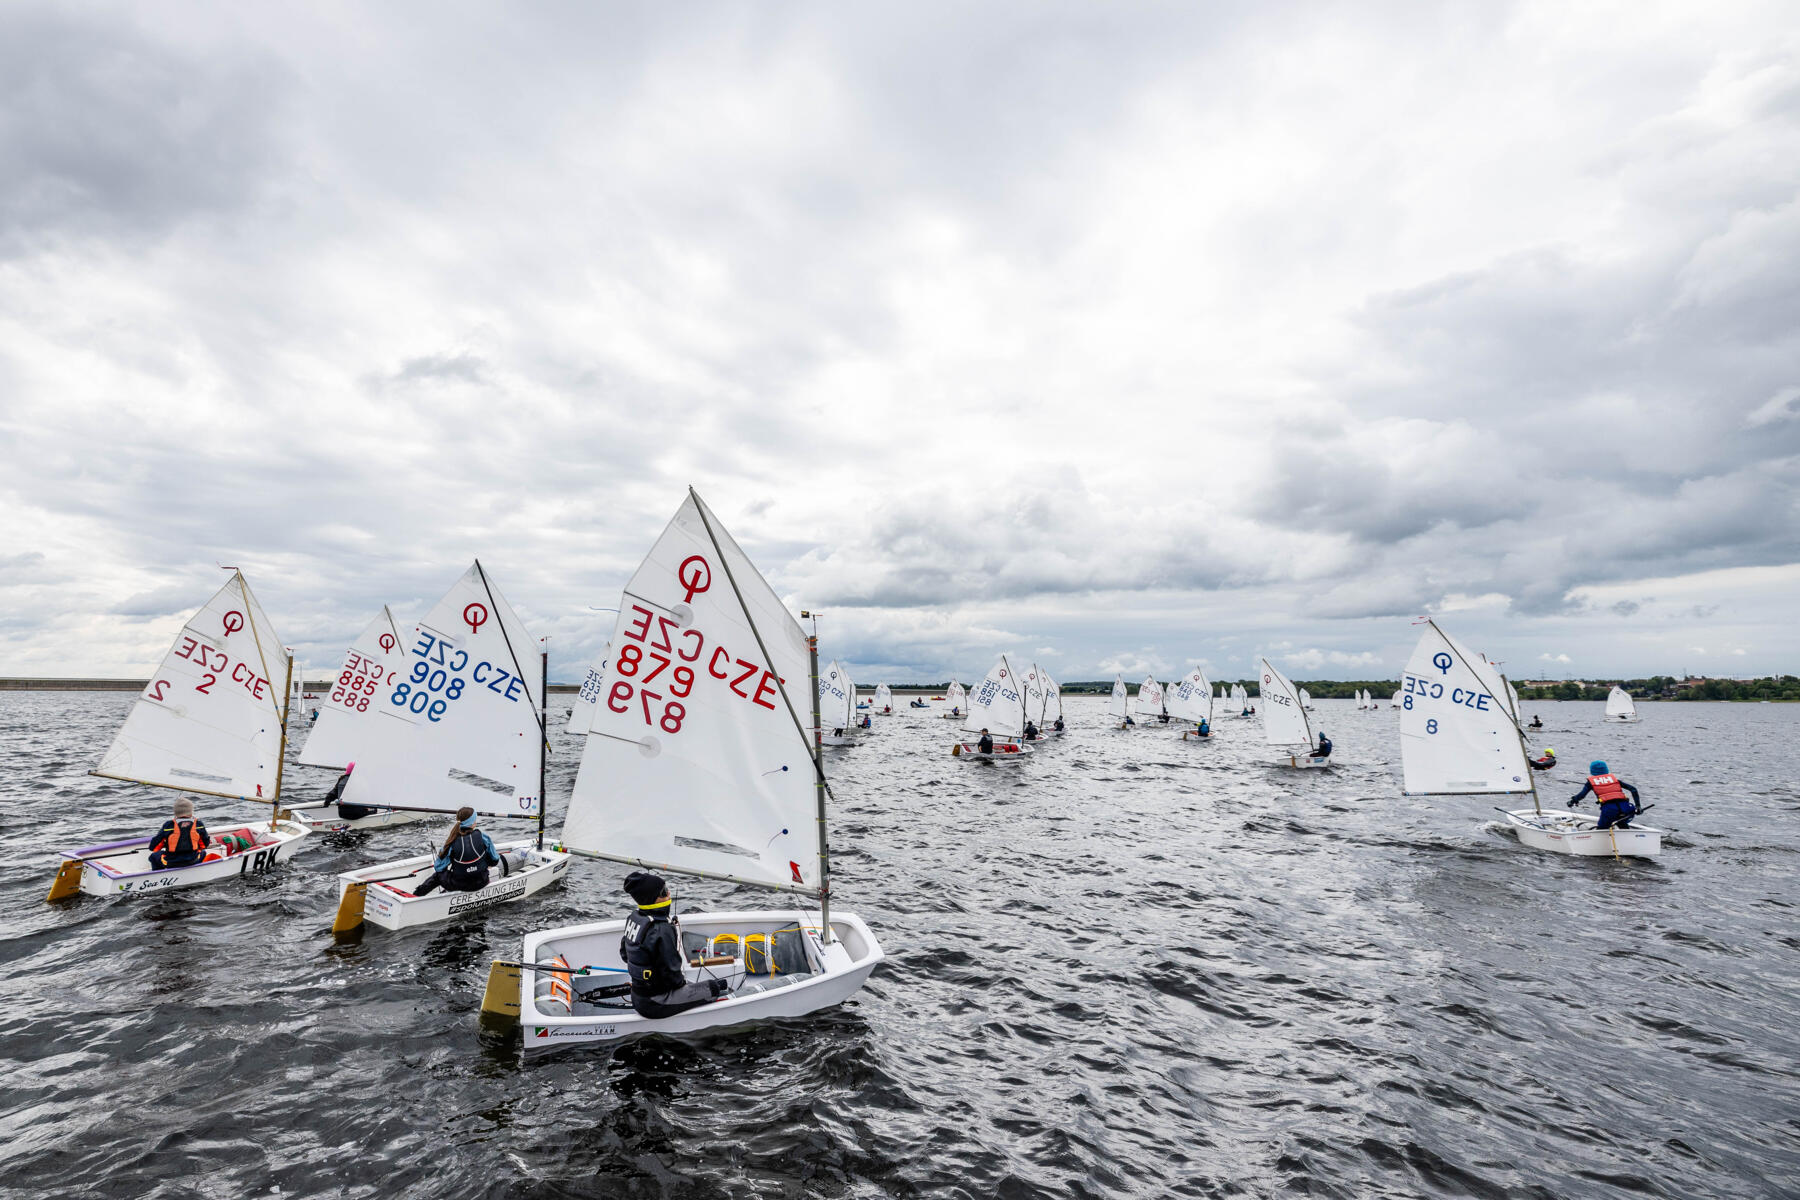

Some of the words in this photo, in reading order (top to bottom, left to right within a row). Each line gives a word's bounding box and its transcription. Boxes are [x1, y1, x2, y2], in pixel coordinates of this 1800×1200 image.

[231, 662, 270, 701] CZE
[409, 661, 465, 700] 908
[473, 661, 525, 703] CZE
[616, 644, 695, 698] 879
[708, 646, 785, 711] CZE
[195, 673, 216, 695] 2
[339, 670, 378, 696] 885
[981, 688, 995, 699] 851
[1001, 689, 1019, 701] CZE
[1273, 694, 1291, 706] CZE
[1403, 695, 1413, 710] 8
[1452, 688, 1492, 711] CZE
[475, 885, 507, 901] SAILING
[509, 879, 528, 891] TEAM
[625, 919, 640, 942] HH
